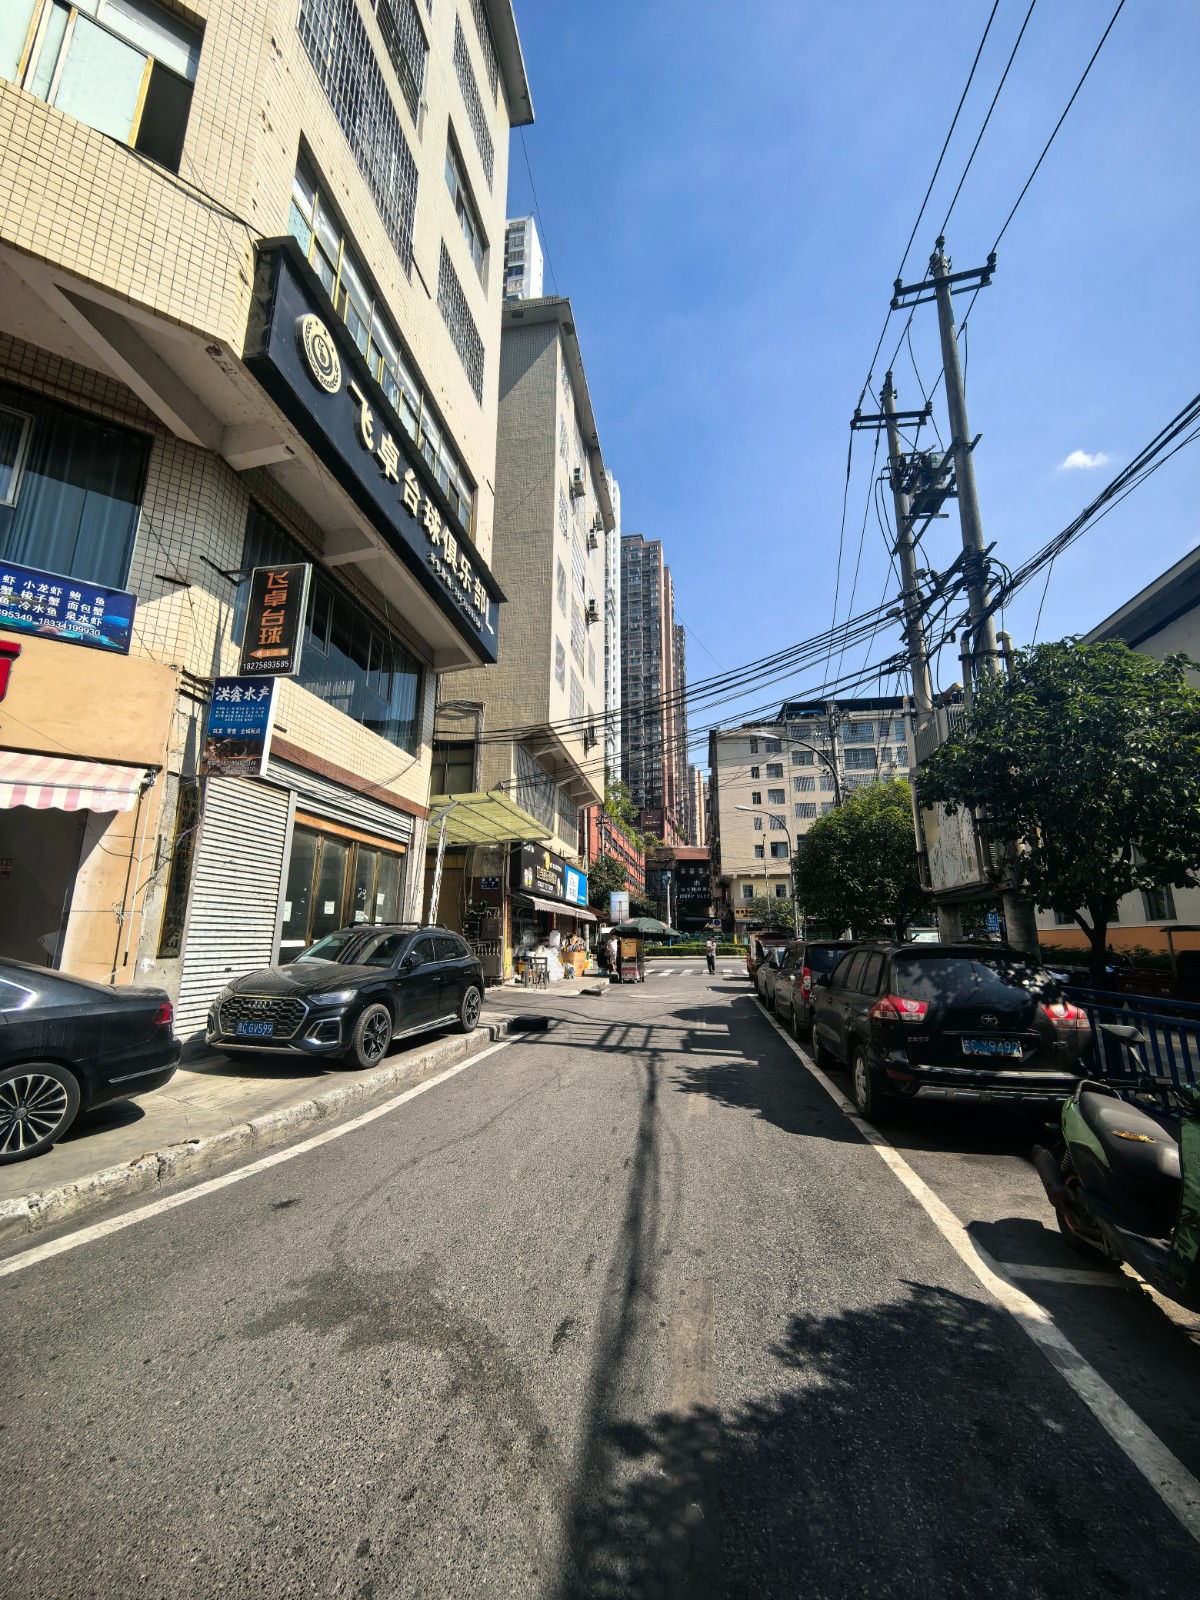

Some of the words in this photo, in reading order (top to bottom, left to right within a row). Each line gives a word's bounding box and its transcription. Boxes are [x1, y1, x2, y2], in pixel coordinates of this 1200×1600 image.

[350, 379, 487, 615] 飞卓台球俱乐部
[17, 600, 58, 618] 冷水鱼
[67, 600, 105, 617] 面包蟹
[258, 570, 289, 645] 飞卓台球
[38, 617, 101, 637] 18334199930
[215, 685, 270, 703] 洪鑫水产
